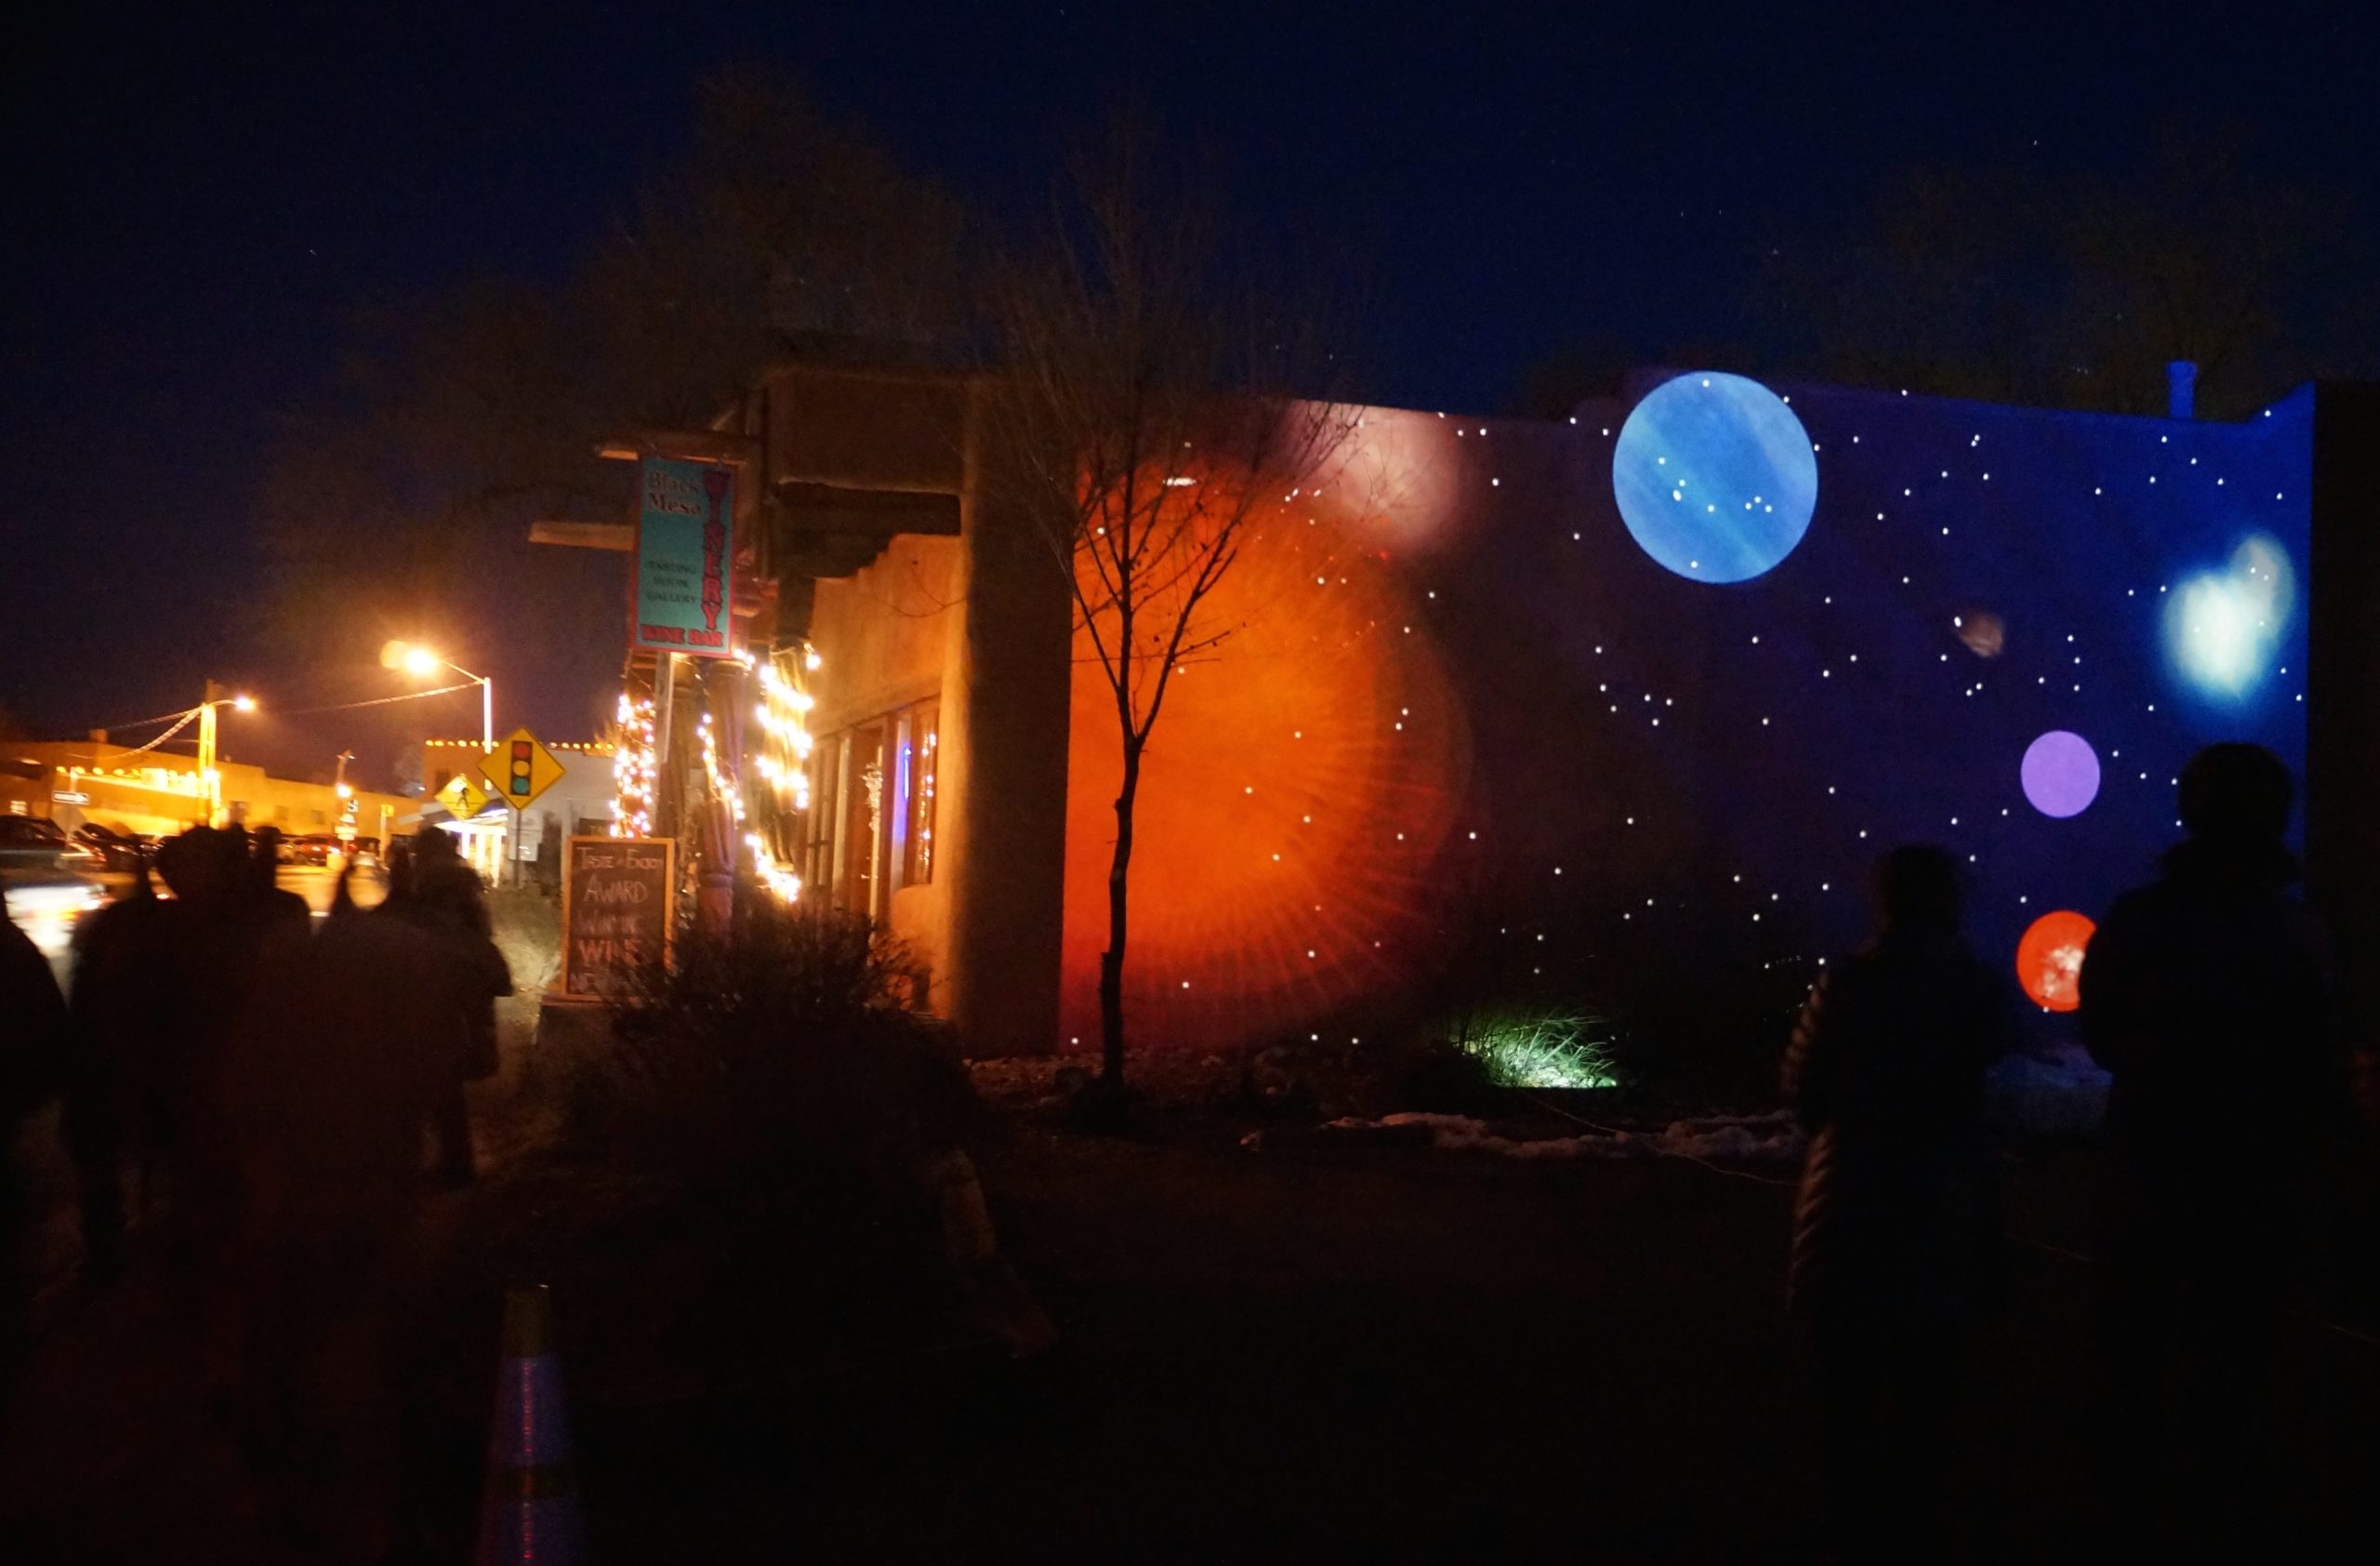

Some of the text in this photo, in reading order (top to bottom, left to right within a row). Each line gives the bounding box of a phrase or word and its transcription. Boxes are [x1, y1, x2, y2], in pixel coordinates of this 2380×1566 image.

[650, 471, 699, 493] Black
[649, 493, 701, 514] Mesa
[585, 873, 647, 902] AWARD
